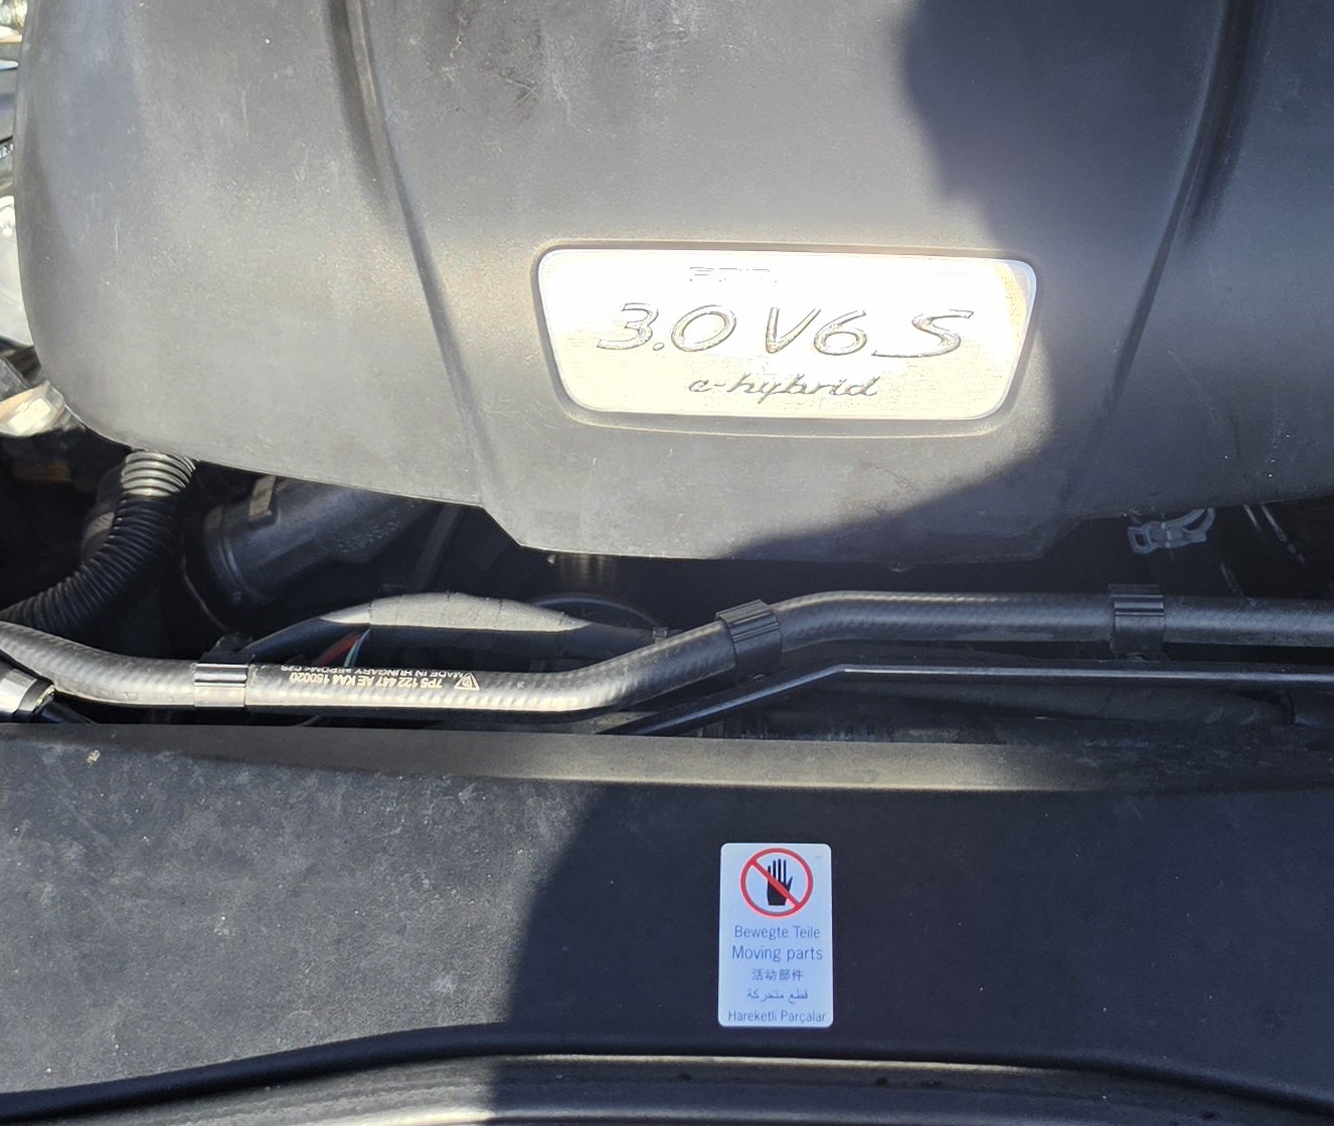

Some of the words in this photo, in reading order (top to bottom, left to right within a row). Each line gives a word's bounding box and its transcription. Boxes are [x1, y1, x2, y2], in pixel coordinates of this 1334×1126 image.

[596, 301, 738, 354] 3.0
[765, 306, 869, 356] V6
[871, 308, 975, 358] S
[688, 373, 881, 404] e-hybrid
[354, 668, 413, 677] HUNGARY
[430, 671, 464, 679] MADE
[357, 675, 375, 687] AE
[375, 676, 397, 688] 447
[398, 677, 418, 689] 122
[420, 677, 443, 689] 7P5
[735, 925, 788, 940] Bewegte
[793, 925, 820, 938] Teile
[732, 945, 782, 962] Moving
[787, 947, 823, 962] parts
[752, 968, 803, 981] 活动部件
[728, 1010, 777, 1022] Hareketli
[781, 1010, 826, 1024] Parçalar
